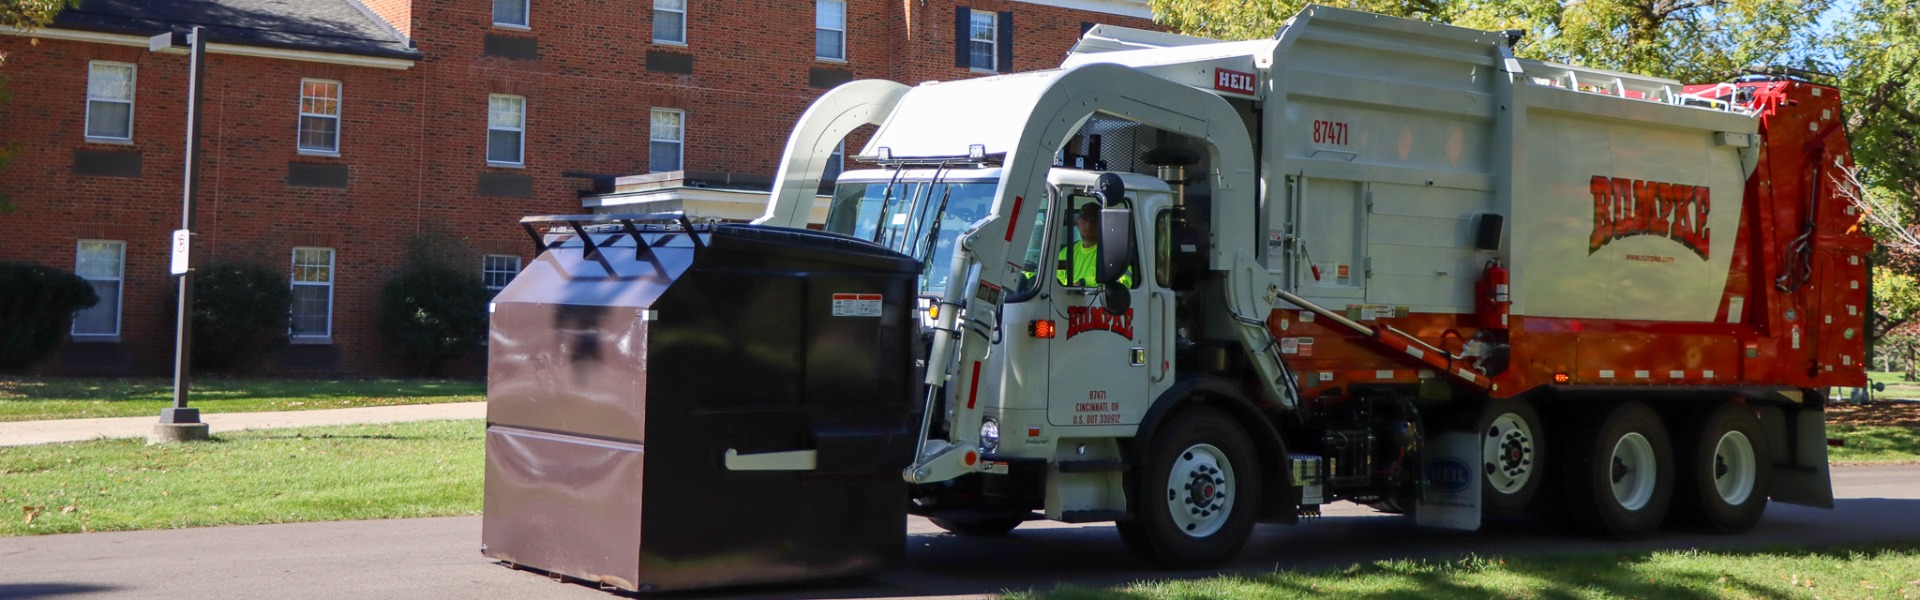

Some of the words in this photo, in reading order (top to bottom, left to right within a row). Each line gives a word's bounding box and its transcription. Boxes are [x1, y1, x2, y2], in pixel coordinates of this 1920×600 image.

[1218, 72, 1254, 92] HEIL
[1313, 120, 1348, 146] 87471
[1588, 175, 1711, 262] RUMPKE
[1089, 391, 1106, 399] 87471
[1112, 402, 1119, 411] OH
[1073, 415, 1084, 424] U.S.
[1087, 415, 1098, 424] DOT
[1100, 414, 1120, 423] 330912
